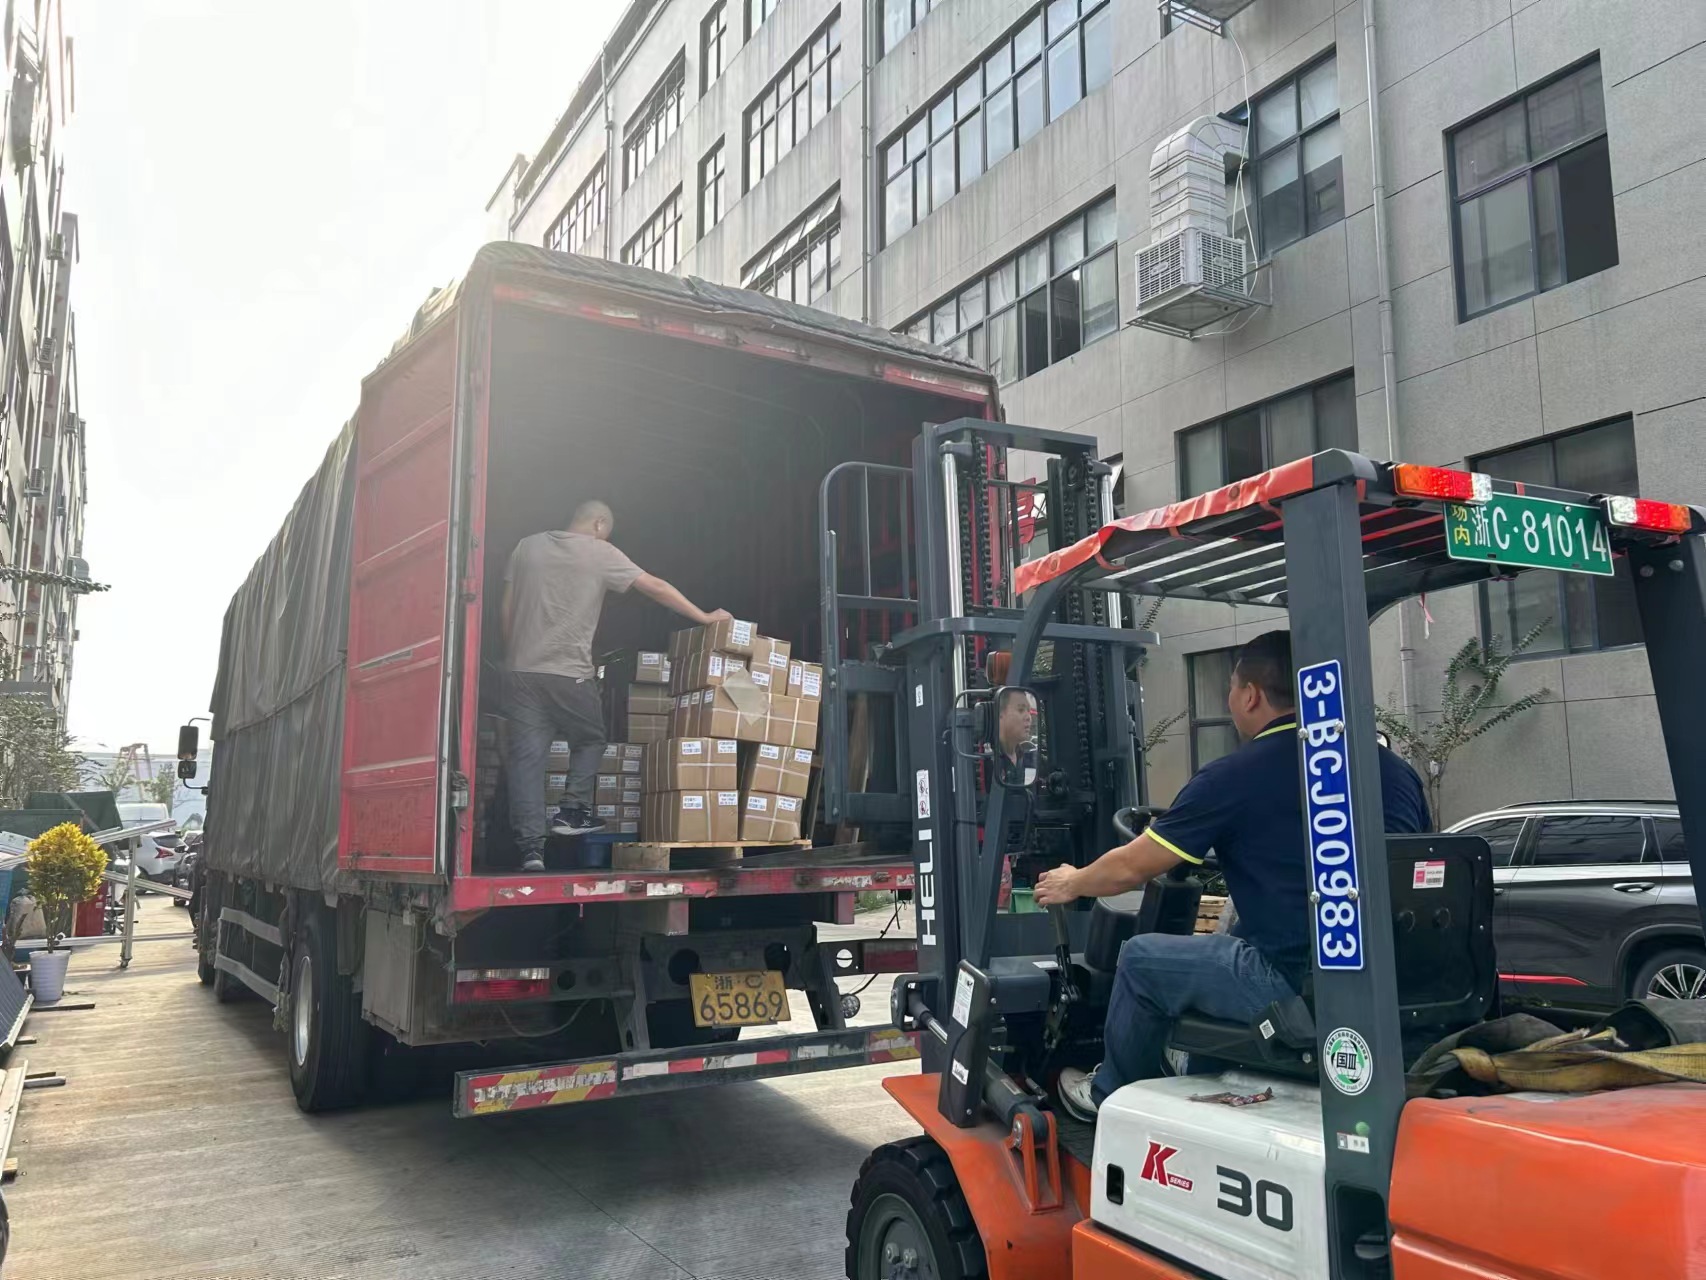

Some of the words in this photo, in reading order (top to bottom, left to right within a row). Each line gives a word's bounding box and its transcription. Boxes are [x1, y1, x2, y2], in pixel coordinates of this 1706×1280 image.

[1303, 671, 1357, 959] 3-BCJ00983
[918, 829, 937, 946] HELI
[701, 991, 783, 1021] 65869
[1140, 1140, 1179, 1188] K
[1169, 1175, 1191, 1189] SERIES
[1216, 1165, 1294, 1232] 30
